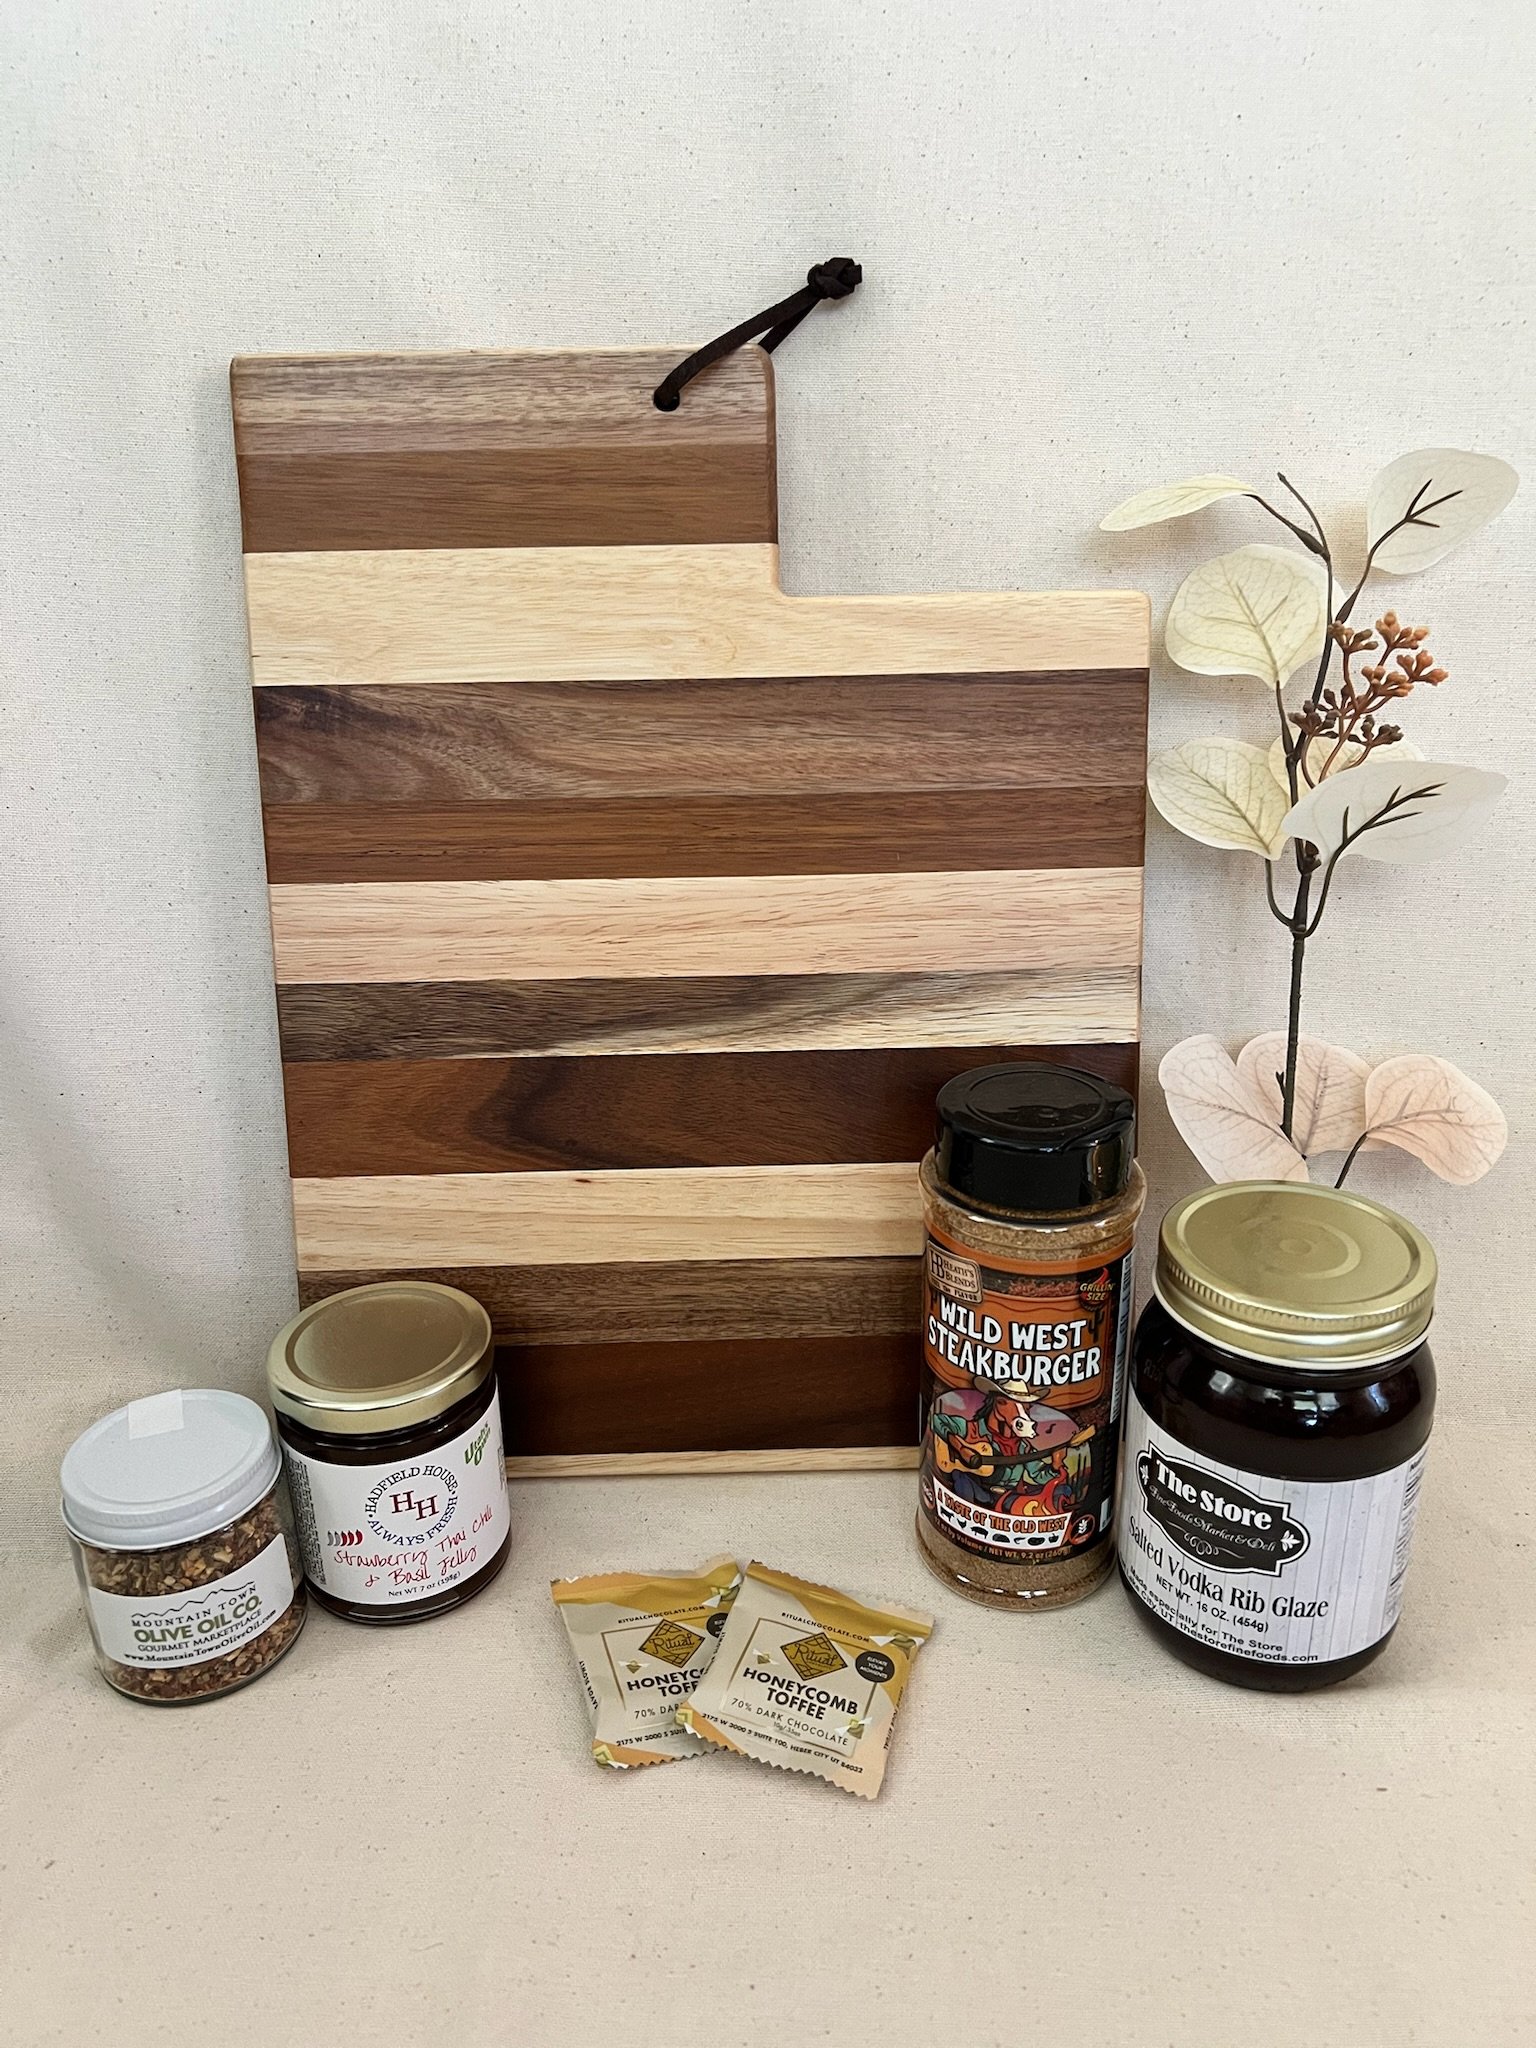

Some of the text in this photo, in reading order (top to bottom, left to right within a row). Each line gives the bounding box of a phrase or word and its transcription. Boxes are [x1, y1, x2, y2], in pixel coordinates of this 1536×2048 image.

[945, 1270, 976, 1289] BLENDS
[1087, 1292, 1106, 1301] SIZE
[939, 1294, 1087, 1351] WILD WEST
[928, 1314, 1101, 1387] STEAKBURGER
[365, 1466, 420, 1513] HADFIELD
[422, 1465, 458, 1492] HOUSE
[1156, 1459, 1273, 1531] The Store
[368, 1496, 458, 1546] ALWAYS FRESH
[944, 1492, 971, 1521] TASTE
[973, 1510, 987, 1526] OF
[989, 1515, 1011, 1532] THE
[1012, 1518, 1036, 1534] OLD
[1038, 1516, 1067, 1533] WEST
[334, 1549, 428, 1568] Strawberry
[435, 1527, 467, 1551] Thai
[956, 1533, 983, 1551] Volume
[989, 1547, 1003, 1556] NET
[1247, 1537, 1277, 1552] Deli
[388, 1564, 430, 1586] Basil
[437, 1545, 477, 1576] Jelly
[1129, 1515, 1163, 1568] Salted
[1168, 1555, 1223, 1603] Vodka
[1230, 1587, 1265, 1614] Rib
[1272, 1596, 1329, 1618] Glaze
[131, 1585, 257, 1627] MOUNTAIN TOWN
[404, 1586, 417, 1594] WT
[1156, 1573, 1269, 1634] NET WT. 16 OZ. (454g)
[134, 1595, 263, 1643] OLIVE OIL CO.
[138, 1609, 262, 1653] GOURMET MARKETPLACE
[617, 1605, 706, 1624] RITUALCHOCOLATE.COM
[781, 1612, 870, 1643] RITUALCHOCOLATE.COM
[1149, 1590, 1198, 1627] especially
[1201, 1623, 1219, 1636] for
[1222, 1631, 1245, 1645] The
[1248, 1639, 1283, 1652] Store
[124, 1610, 276, 1662] www.MountainTownOliveOil.com
[649, 1633, 695, 1655] Ritual
[790, 1642, 839, 1667] Ritual
[1161, 1608, 1175, 1622] UT
[1179, 1622, 1318, 1663] thestorefinefoods.com
[627, 1667, 704, 1691] HONEYC
[658, 1681, 698, 1697] TOFF
[742, 1667, 858, 1715] HONEYCOMB
[634, 1702, 683, 1719] 70% DAR
[731, 1697, 849, 1746] 70% DARK CHOCOLATE
[767, 1687, 826, 1720] TOFFEE
[754, 1731, 773, 1742] SUITE
[814, 1750, 829, 1759] CITY
[830, 1756, 840, 1764] UT
